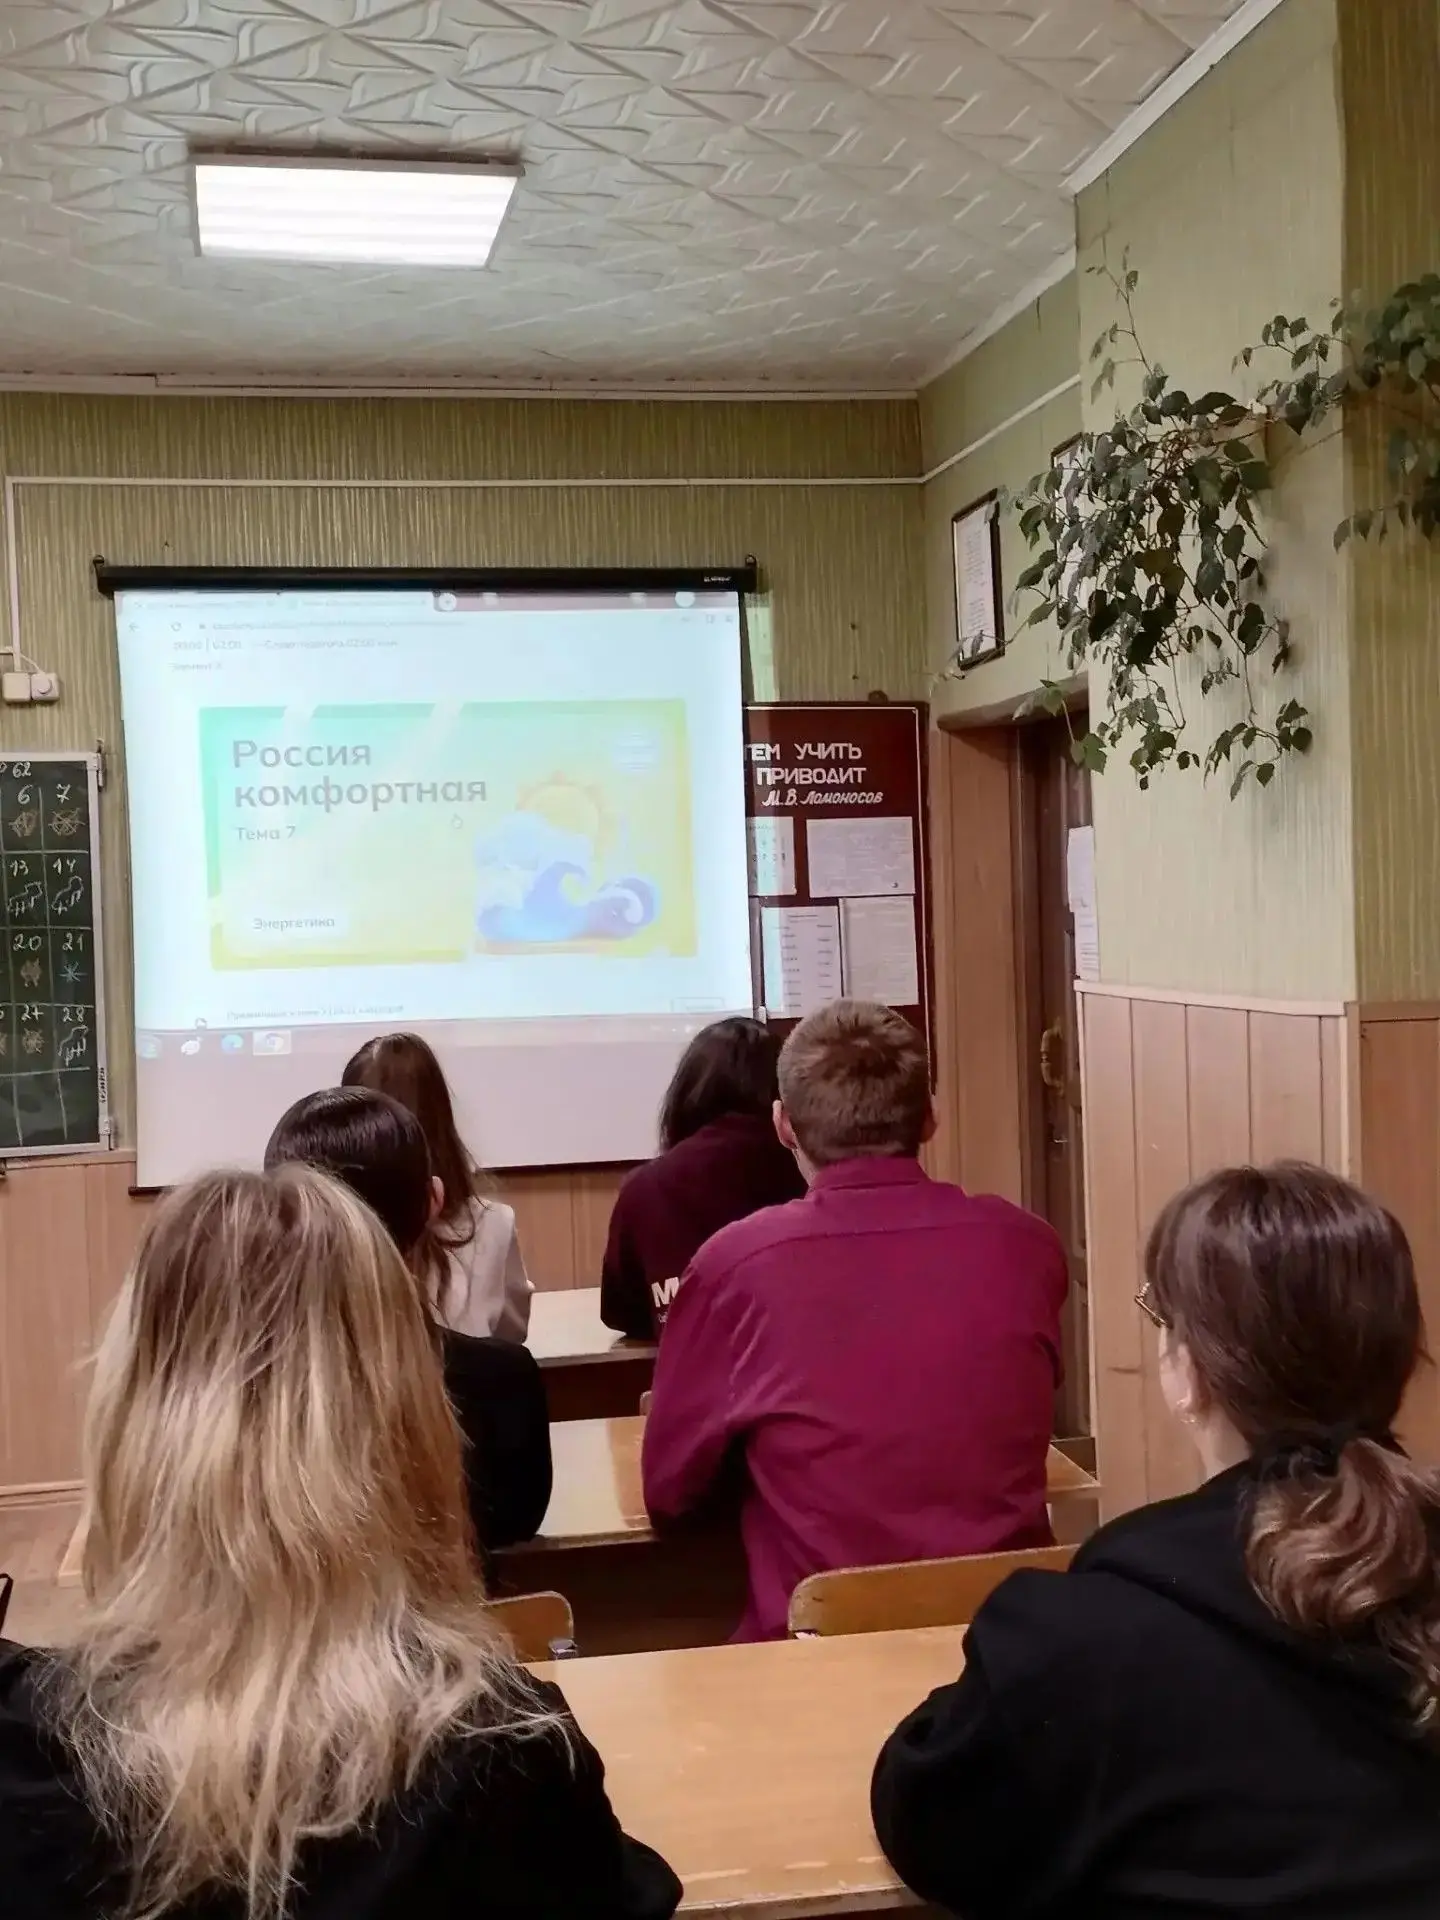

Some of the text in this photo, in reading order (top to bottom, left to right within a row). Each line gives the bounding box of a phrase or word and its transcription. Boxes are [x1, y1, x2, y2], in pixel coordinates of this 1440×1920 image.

[233, 740, 371, 768] Россия
[794, 743, 863, 761] УЧИТЬ
[756, 767, 867, 786] ПРИВОДИТ
[17, 784, 34, 805] 6
[56, 783, 71, 804] 7
[235, 775, 488, 813] комфортная
[800, 791, 884, 806] Ломоносов
[238, 825, 297, 843] Тема 7
[252, 917, 336, 933] Энергетика
[13, 933, 42, 951] 20
[62, 932, 84, 952] 21
[62, 1006, 85, 1023] 28
